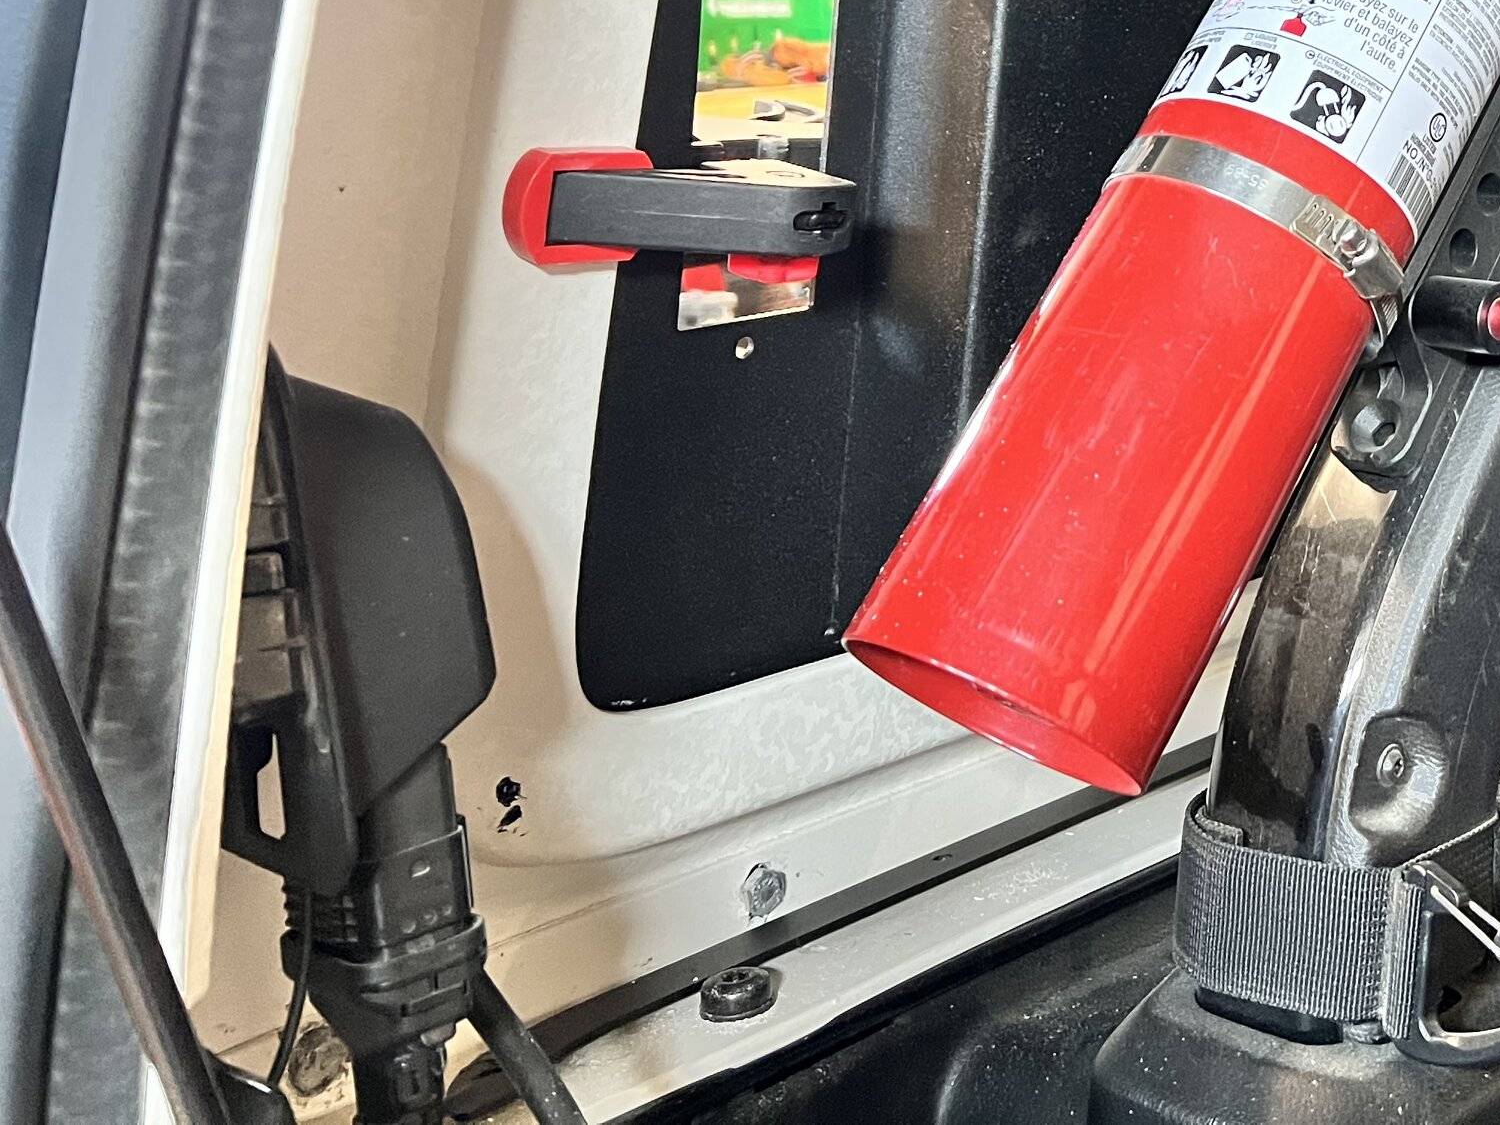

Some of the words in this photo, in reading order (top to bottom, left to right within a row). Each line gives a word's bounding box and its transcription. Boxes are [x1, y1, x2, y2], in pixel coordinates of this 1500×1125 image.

[1344, 17, 1371, 37] d'un
[1372, 32, 1397, 53] côté
[1397, 46, 1405, 59] à
[1358, 10, 1370, 21] et
[1371, 13, 1413, 47] balayez
[1388, 8, 1409, 26] sur
[1408, 19, 1419, 33] le
[1360, 40, 1396, 73] l'autre.
